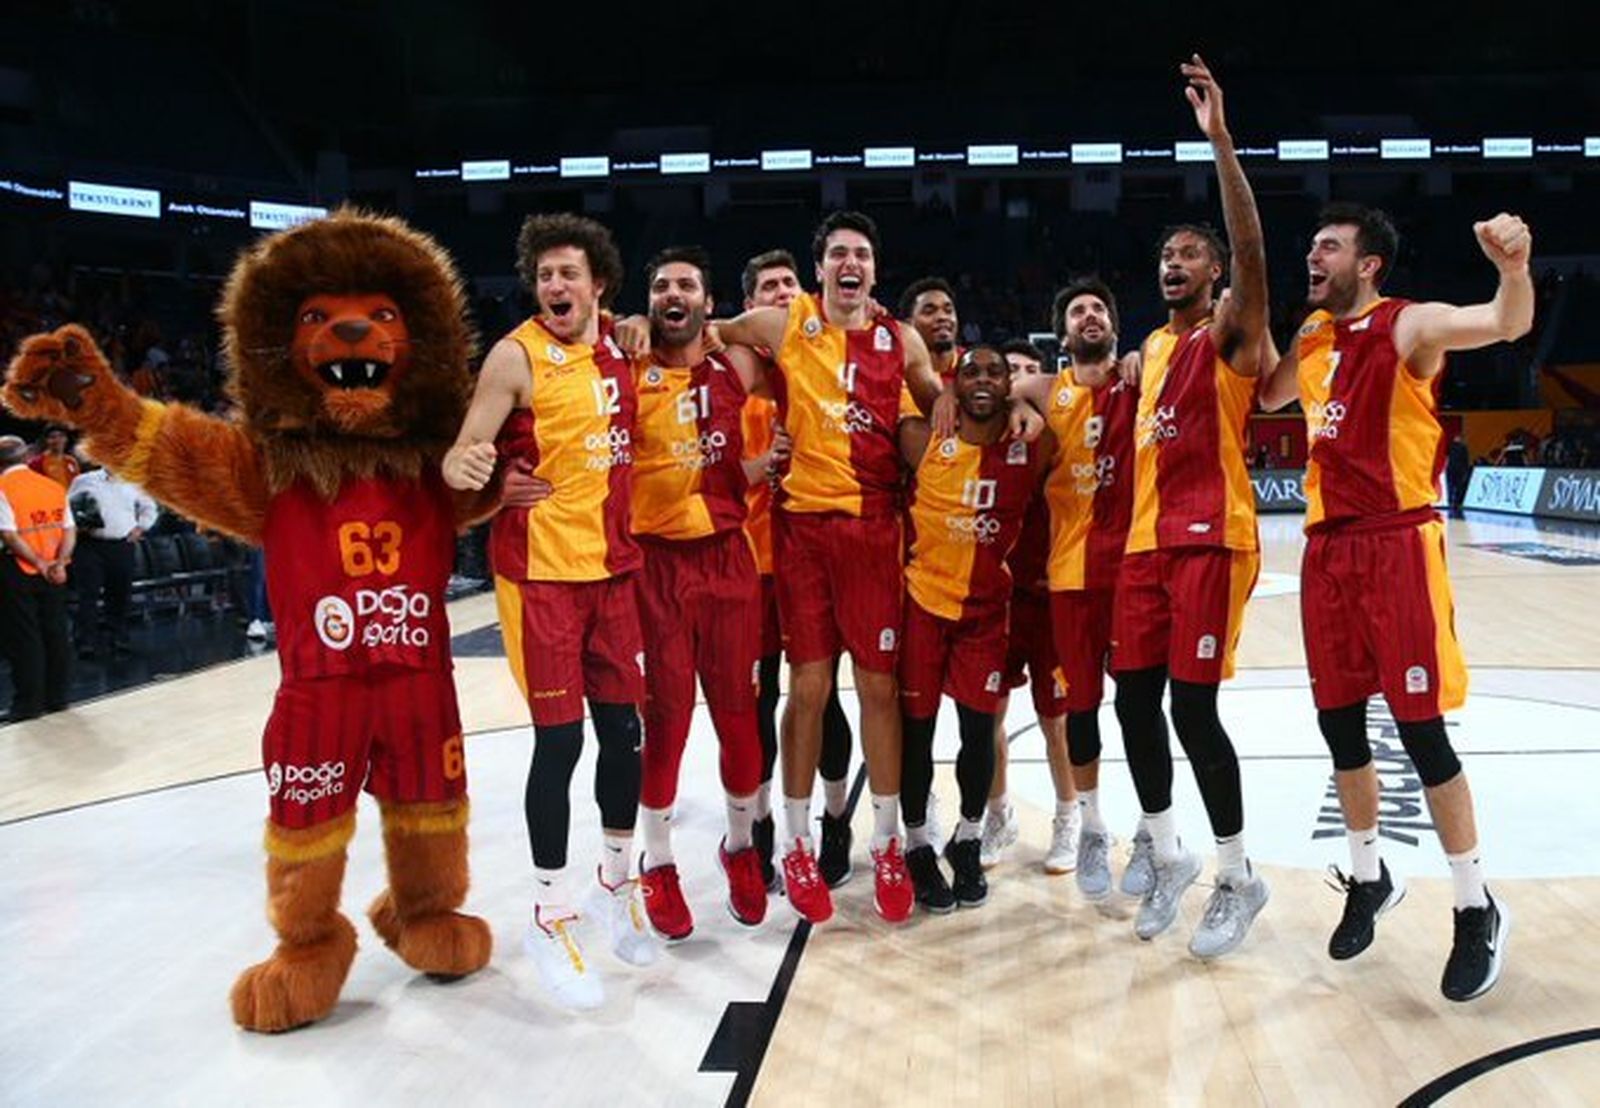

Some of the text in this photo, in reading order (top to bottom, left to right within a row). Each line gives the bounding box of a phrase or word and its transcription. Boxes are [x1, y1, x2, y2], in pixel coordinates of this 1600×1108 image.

[592, 377, 621, 416] 12
[676, 385, 709, 424] 61
[1084, 416, 1103, 448] 8
[961, 479, 997, 509] 10
[339, 520, 402, 577] 63
